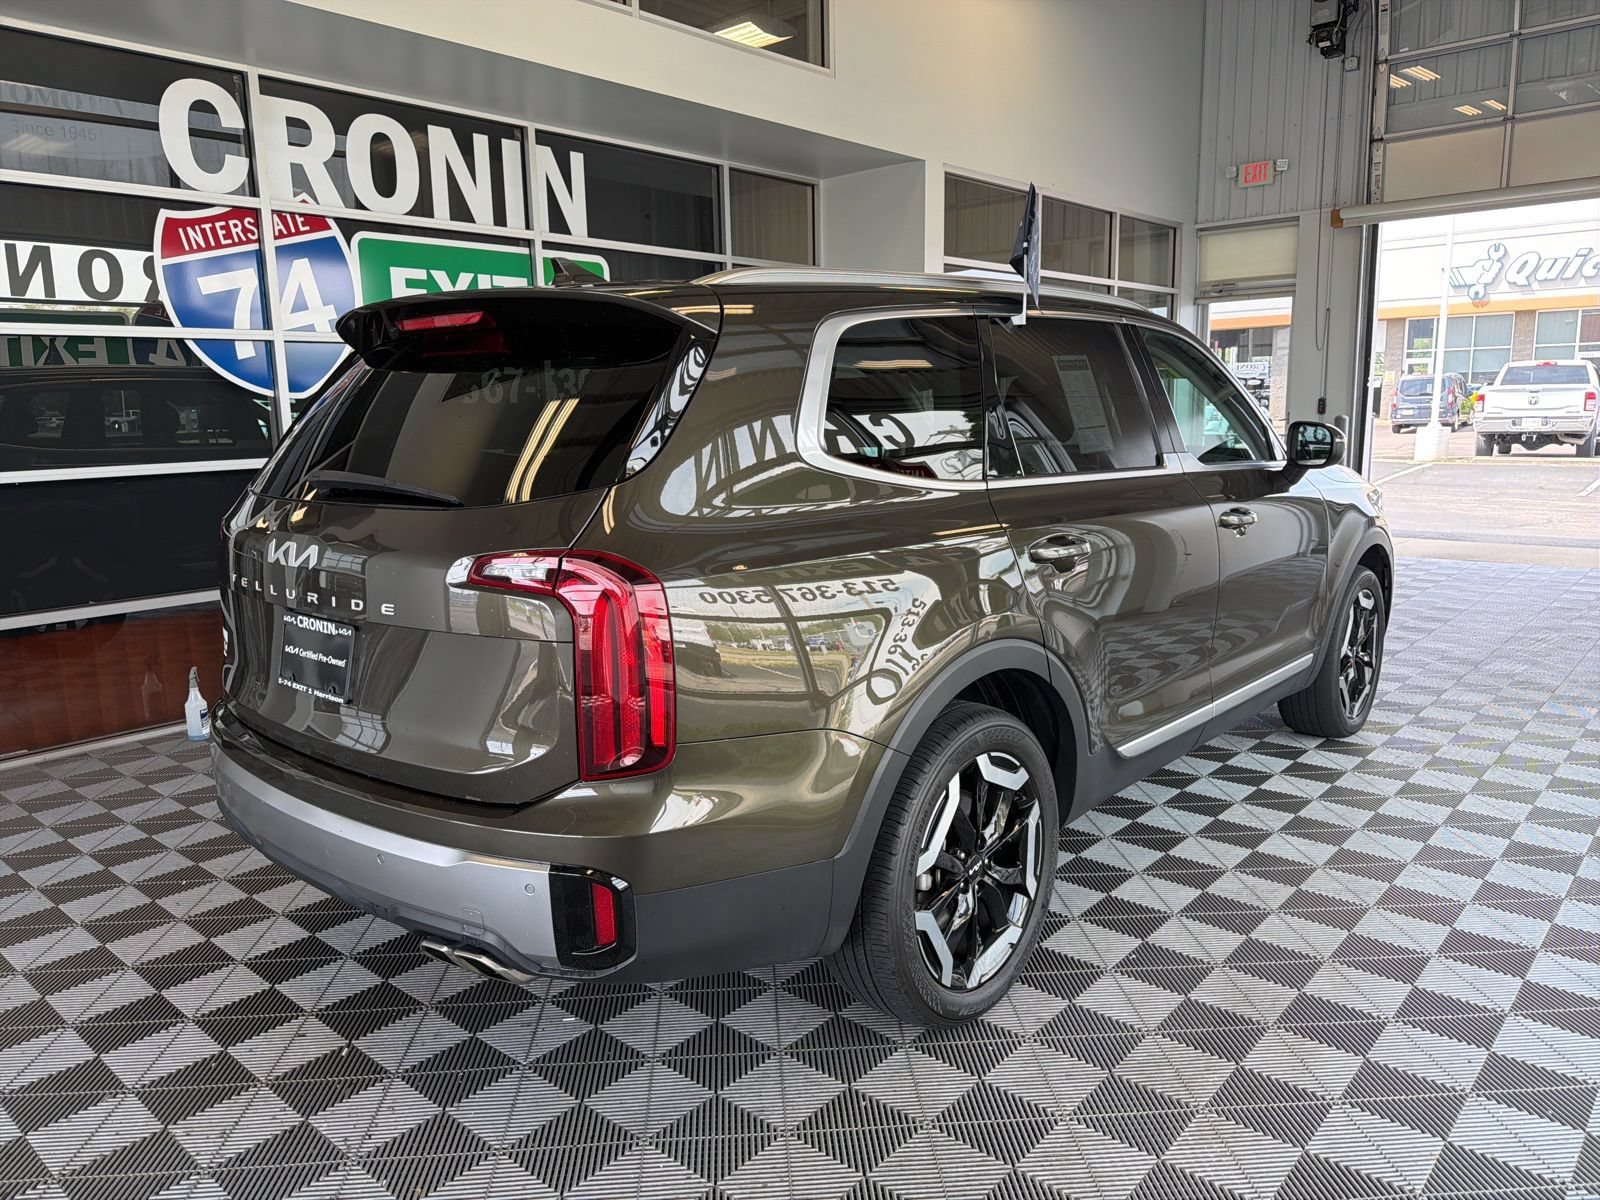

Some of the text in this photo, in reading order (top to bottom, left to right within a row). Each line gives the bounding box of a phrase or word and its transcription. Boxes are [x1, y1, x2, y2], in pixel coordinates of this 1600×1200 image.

[60, 125, 97, 142] 1945
[159, 78, 587, 238] CRONIN
[1244, 162, 1268, 184] EXIT
[178, 213, 310, 251] INTERSATE
[390, 267, 527, 298] EX
[197, 258, 337, 360] 74
[267, 538, 319, 570] KIA
[231, 573, 395, 615] TELLURIDE
[297, 615, 336, 636] CRONIN
[285, 644, 346, 667] KIA Certified Pre-Owned
[292, 682, 308, 692] EXIT
[313, 690, 344, 704] Harrison
